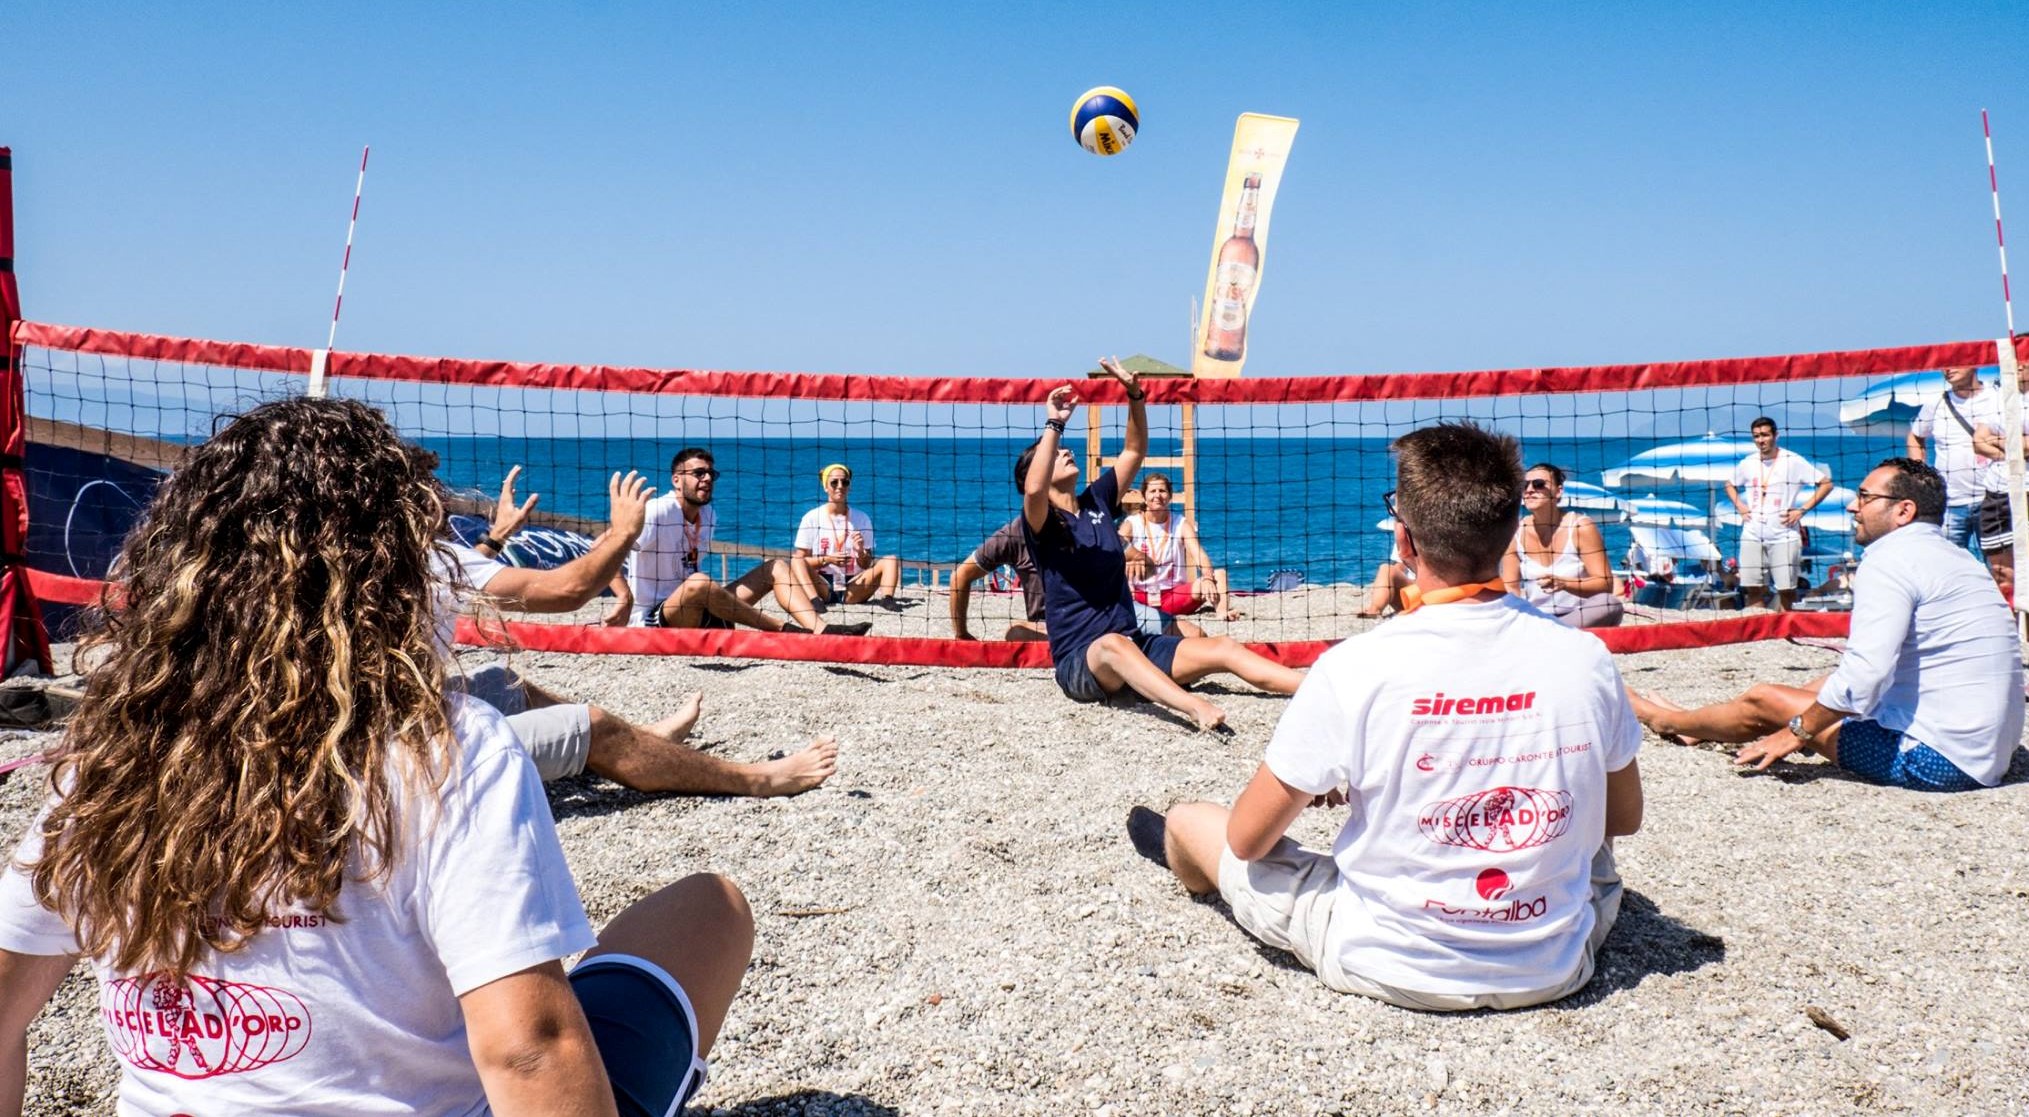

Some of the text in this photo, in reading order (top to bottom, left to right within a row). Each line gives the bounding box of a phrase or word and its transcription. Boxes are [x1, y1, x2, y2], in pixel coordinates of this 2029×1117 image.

[1411, 691, 1537, 716] siremar
[1468, 756, 1505, 767] GRUPPO
[1508, 752, 1554, 764] CARONTE
